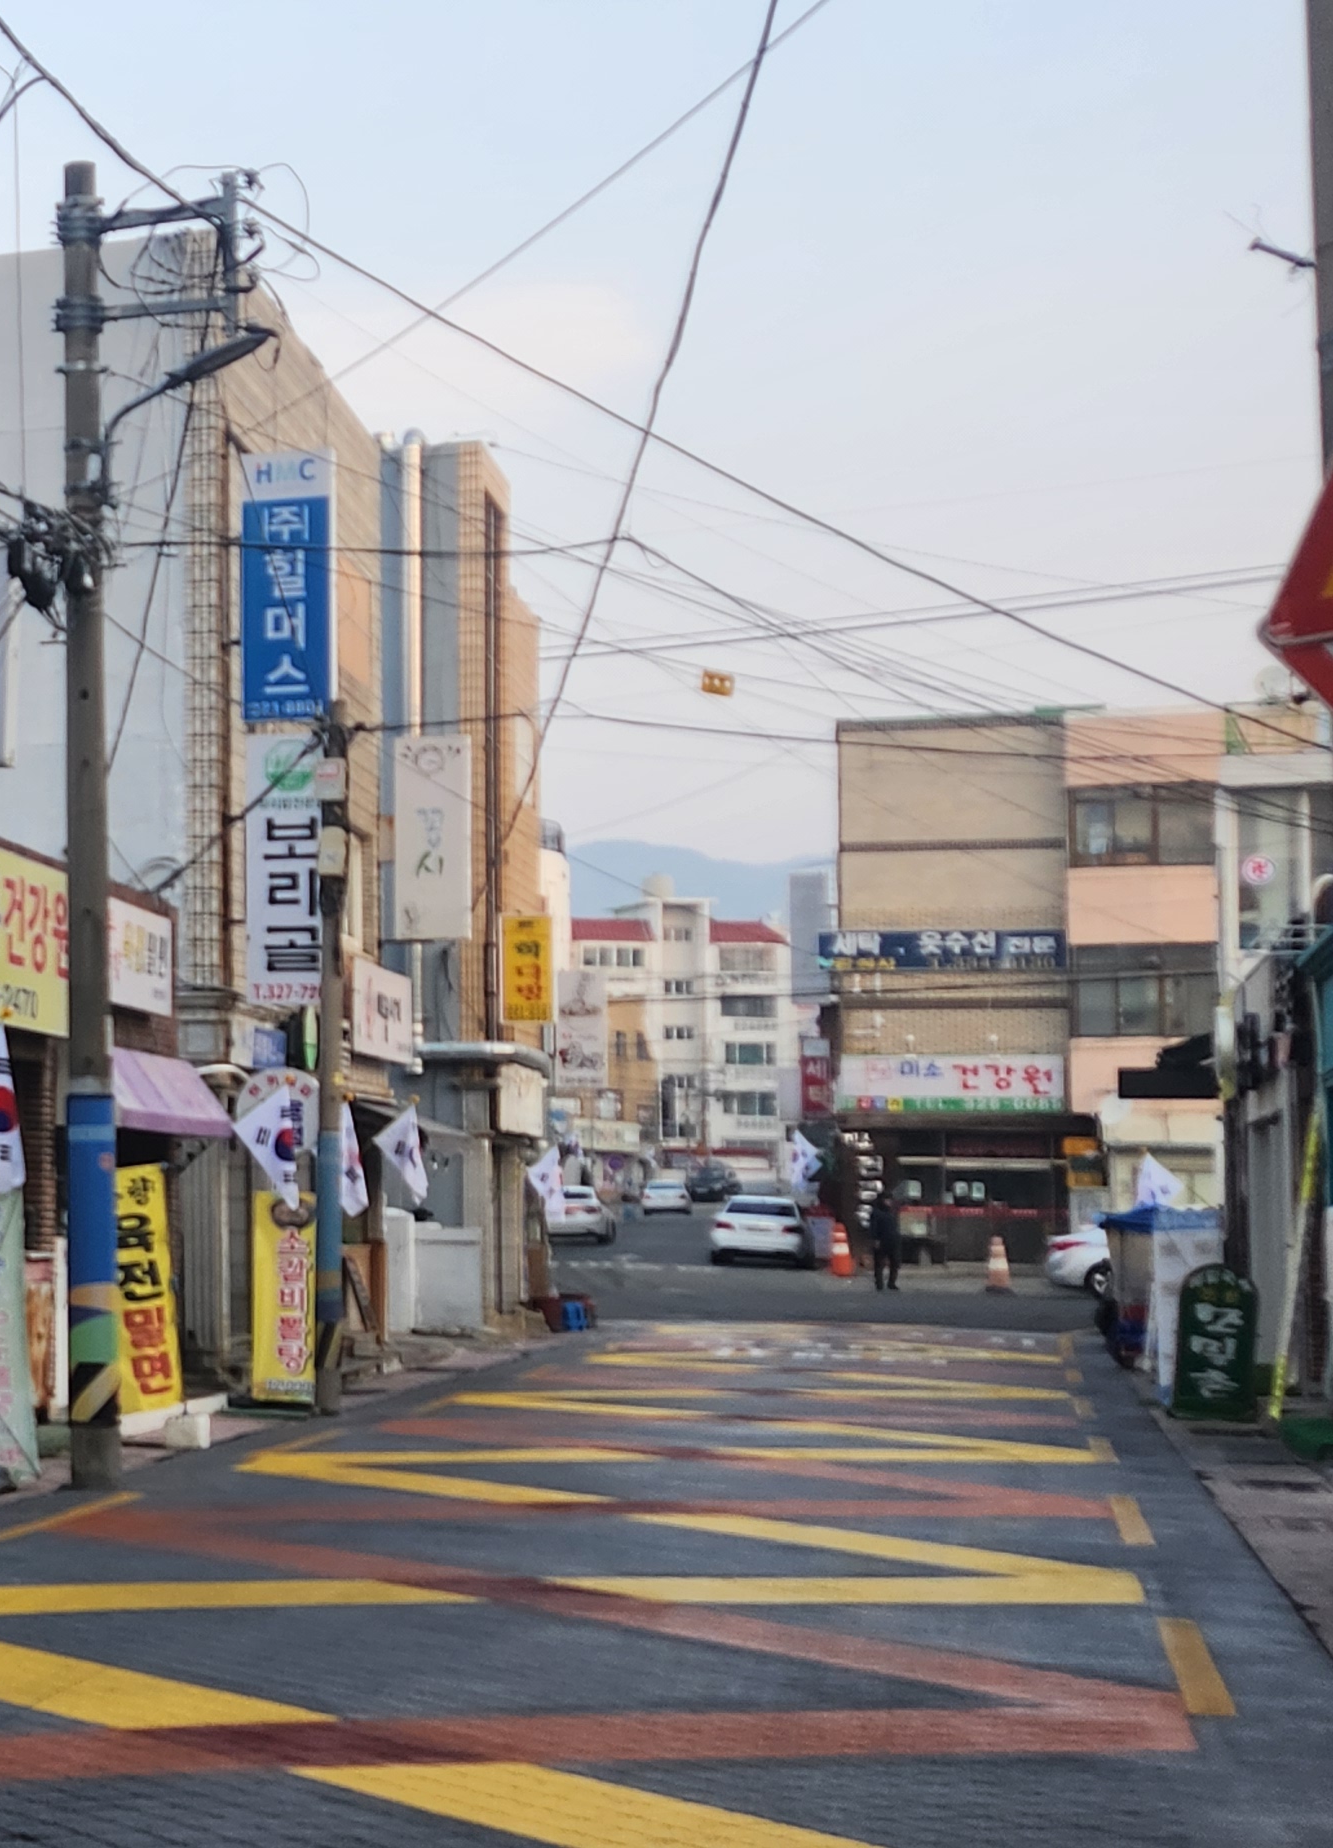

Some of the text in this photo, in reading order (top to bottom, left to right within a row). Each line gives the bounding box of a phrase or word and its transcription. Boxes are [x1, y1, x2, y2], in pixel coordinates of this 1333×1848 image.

[263, 816, 323, 972] 보리골
[900, 1060, 1053, 1095] 미소 건강원
